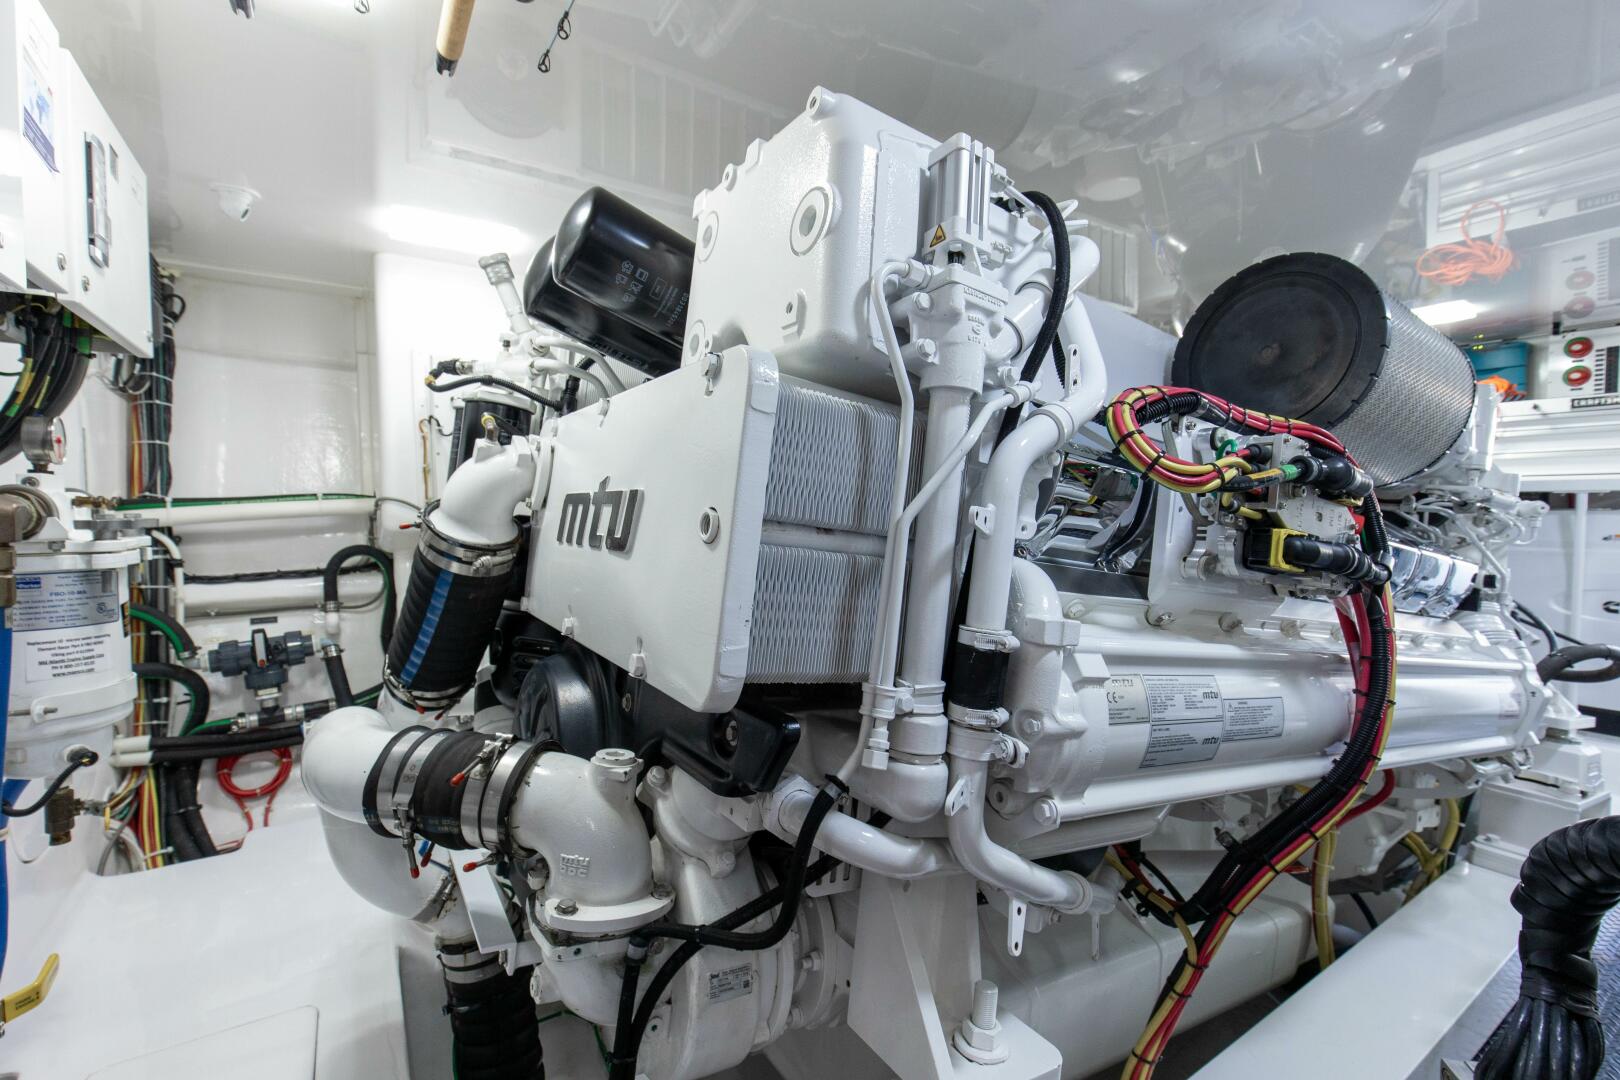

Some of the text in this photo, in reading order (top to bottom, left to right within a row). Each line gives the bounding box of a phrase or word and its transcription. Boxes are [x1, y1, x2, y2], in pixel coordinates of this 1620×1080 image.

[557, 475, 641, 555] mtu
[1202, 690, 1219, 700] mtu
[1202, 736, 1219, 745] mtu
